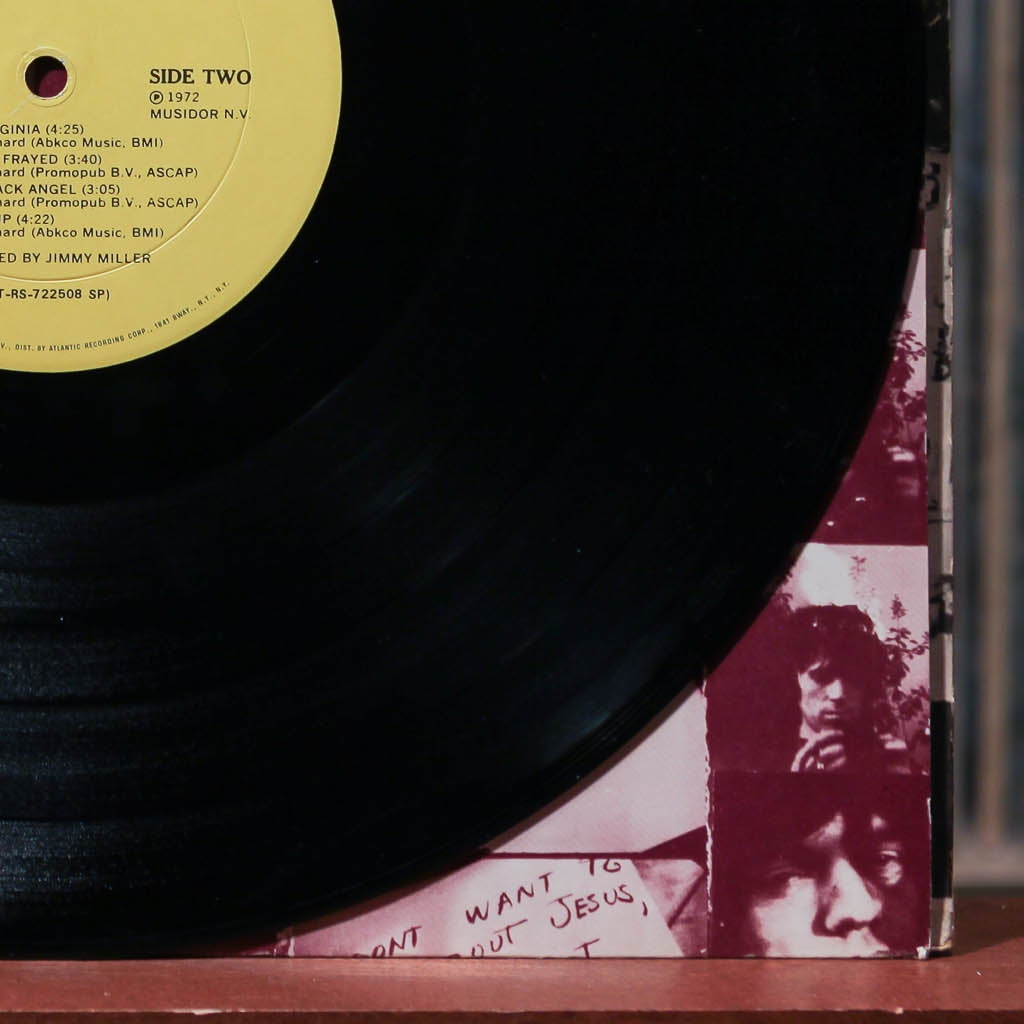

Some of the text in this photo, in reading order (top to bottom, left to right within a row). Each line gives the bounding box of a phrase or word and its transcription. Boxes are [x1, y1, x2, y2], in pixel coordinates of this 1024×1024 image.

[149, 68, 252, 86] SIDE TWO
[168, 91, 200, 103] 1972
[150, 108, 252, 120] MUSIDOR N.V.
[45, 124, 85, 136] (4:25)
[31, 137, 78, 149] (Abkco
[131, 137, 164, 149] BMI)
[3, 154, 58, 165] FRAYED
[64, 154, 103, 166] (3:40)
[30, 167, 106, 180] (Promopub
[147, 167, 199, 179] ASCAP)
[28, 184, 77, 195] ANGEL
[82, 184, 121, 196] (3:05)
[30, 197, 106, 210] (Promopub
[147, 197, 199, 209] ASCAP)
[16, 214, 55, 226] (4:22)
[31, 227, 79, 239] (Abkco
[132, 227, 164, 239] BMI)
[22, 252, 41, 263] BY
[45, 253, 93, 264] JIMMY
[97, 253, 151, 264] MILLER
[88, 288, 111, 301] SP)
[15, 344, 34, 352] DIST.
[48, 343, 81, 352] ATLANTIC
[84, 335, 125, 349] RECORDING
[549, 884, 649, 928] JESUS,
[351, 926, 422, 958] ONT
[466, 872, 552, 924] WANT
